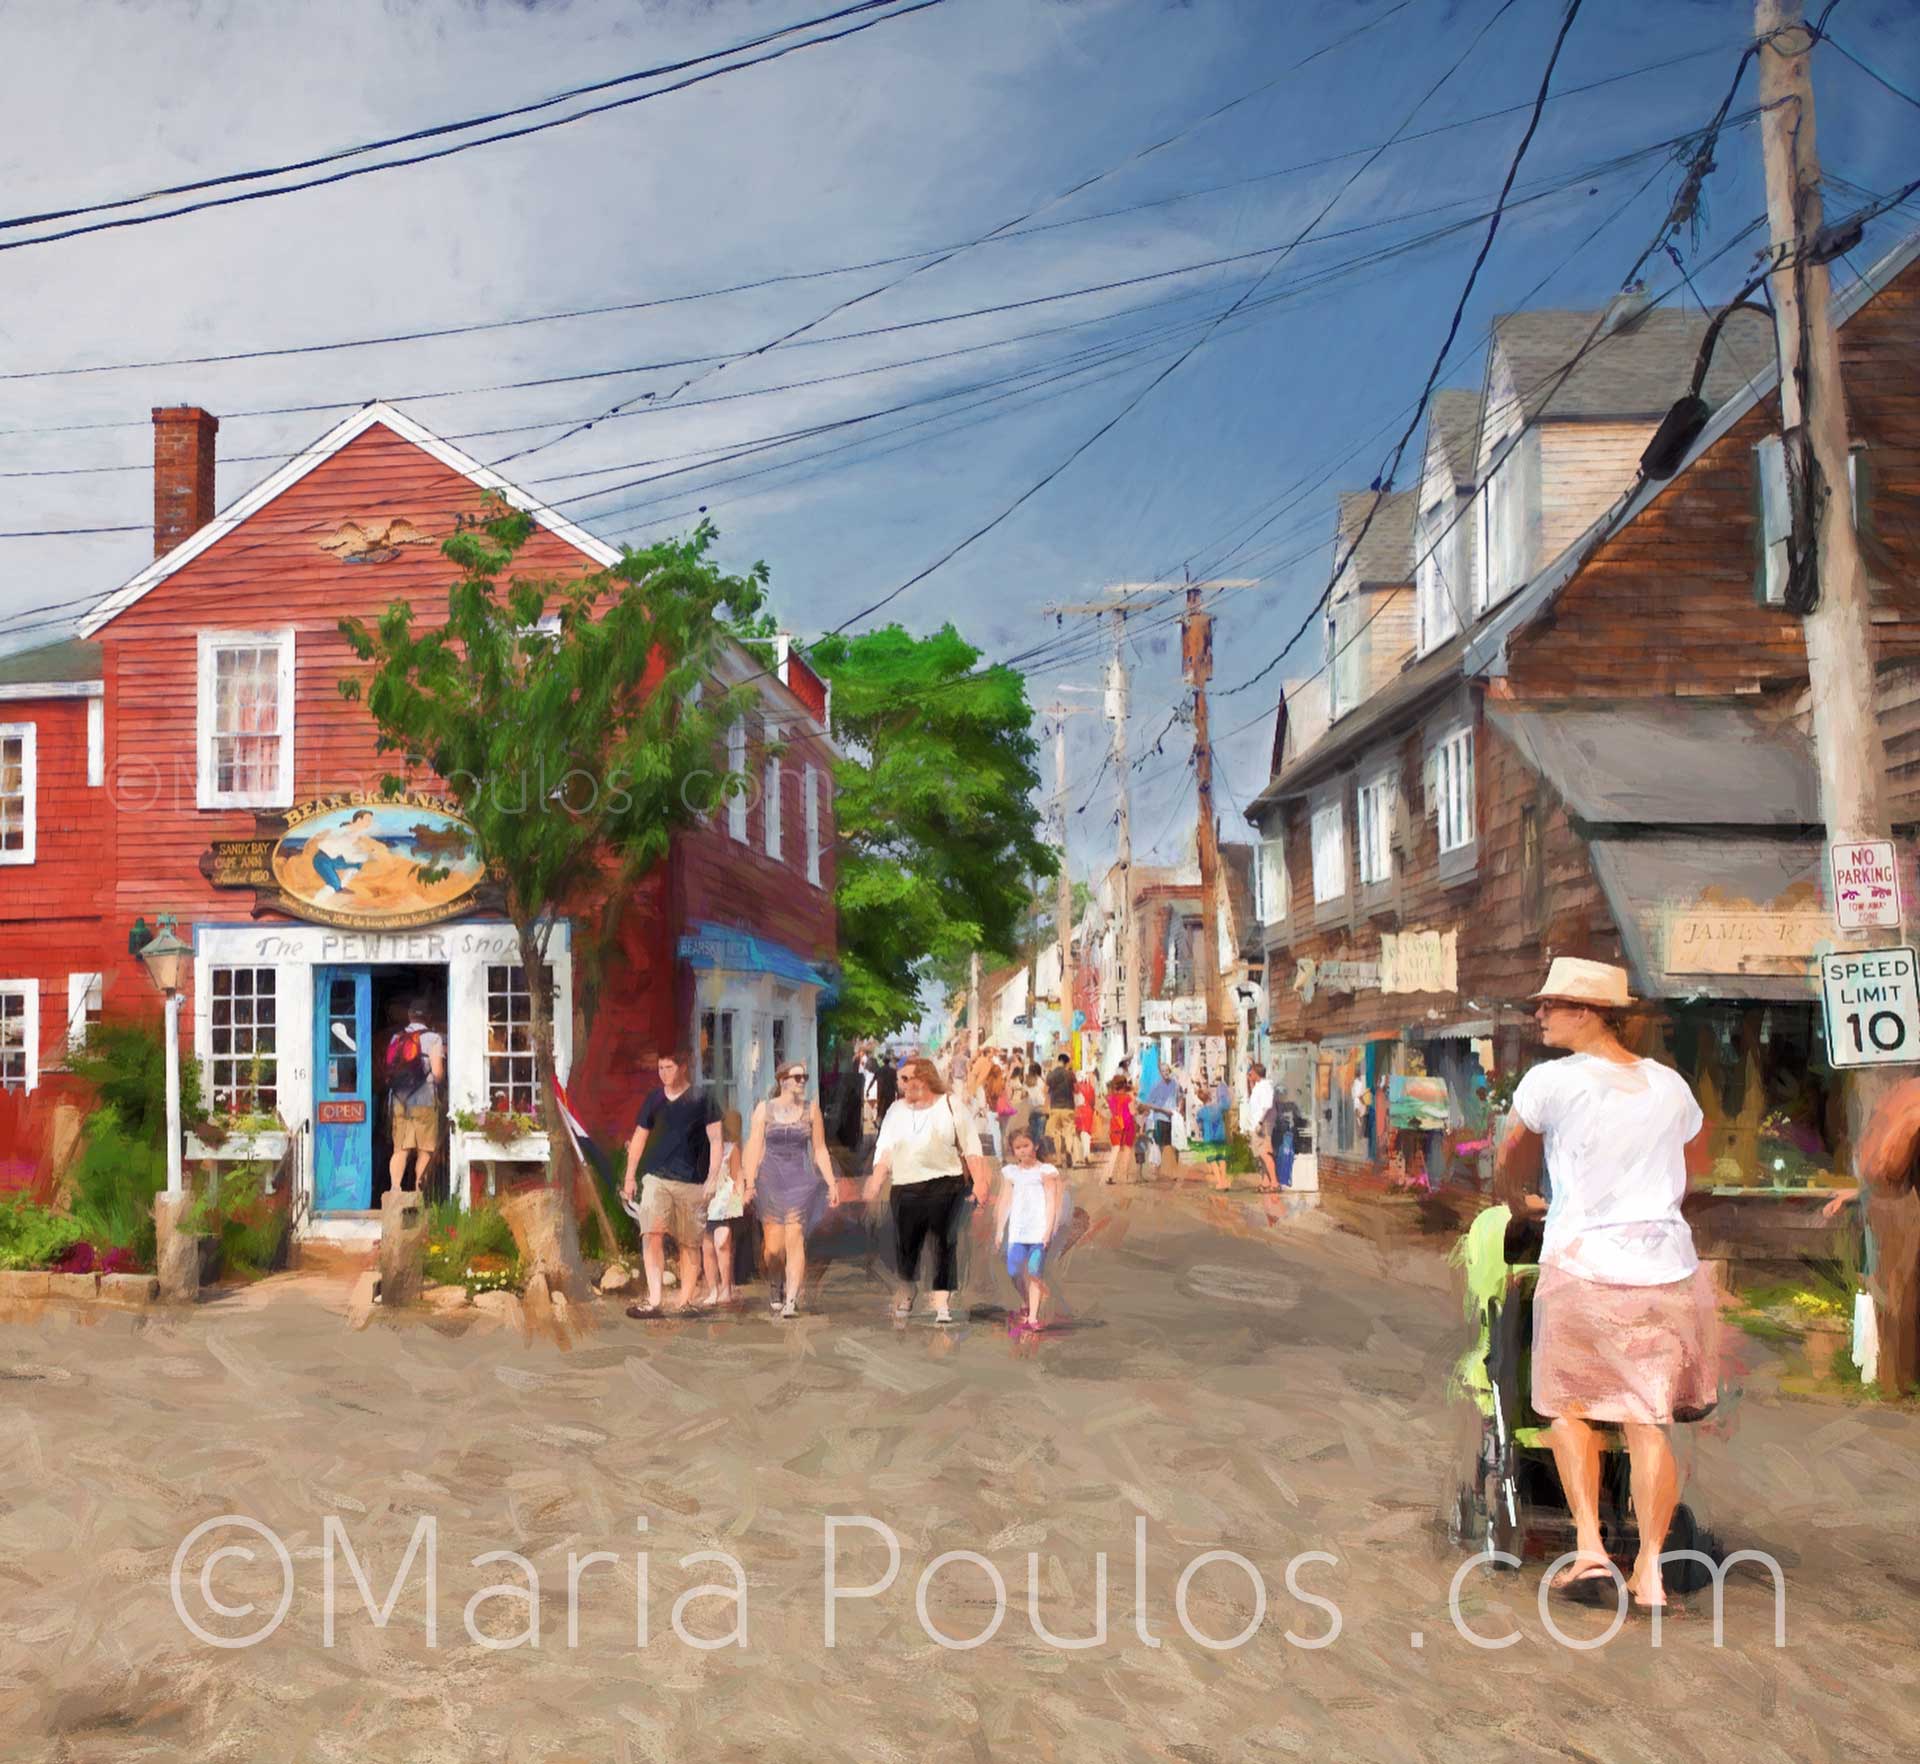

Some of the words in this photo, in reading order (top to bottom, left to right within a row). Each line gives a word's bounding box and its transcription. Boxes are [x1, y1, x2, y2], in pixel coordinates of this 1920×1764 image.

[282, 793, 346, 829] BEAR
[350, 791, 408, 805] SKN
[219, 844, 249, 855] SANDY
[251, 842, 270, 854] BAY
[1851, 849, 1875, 866] NO
[1837, 866, 1892, 885] PARKING
[256, 936, 304, 957] The
[322, 934, 446, 960] PEWTER
[1830, 960, 1909, 980] SPEED
[1841, 985, 1901, 1004] LIMIT
[1847, 1011, 1905, 1052] 10
[294, 1068, 306, 1080] 16
[324, 1105, 362, 1118] OPEN
